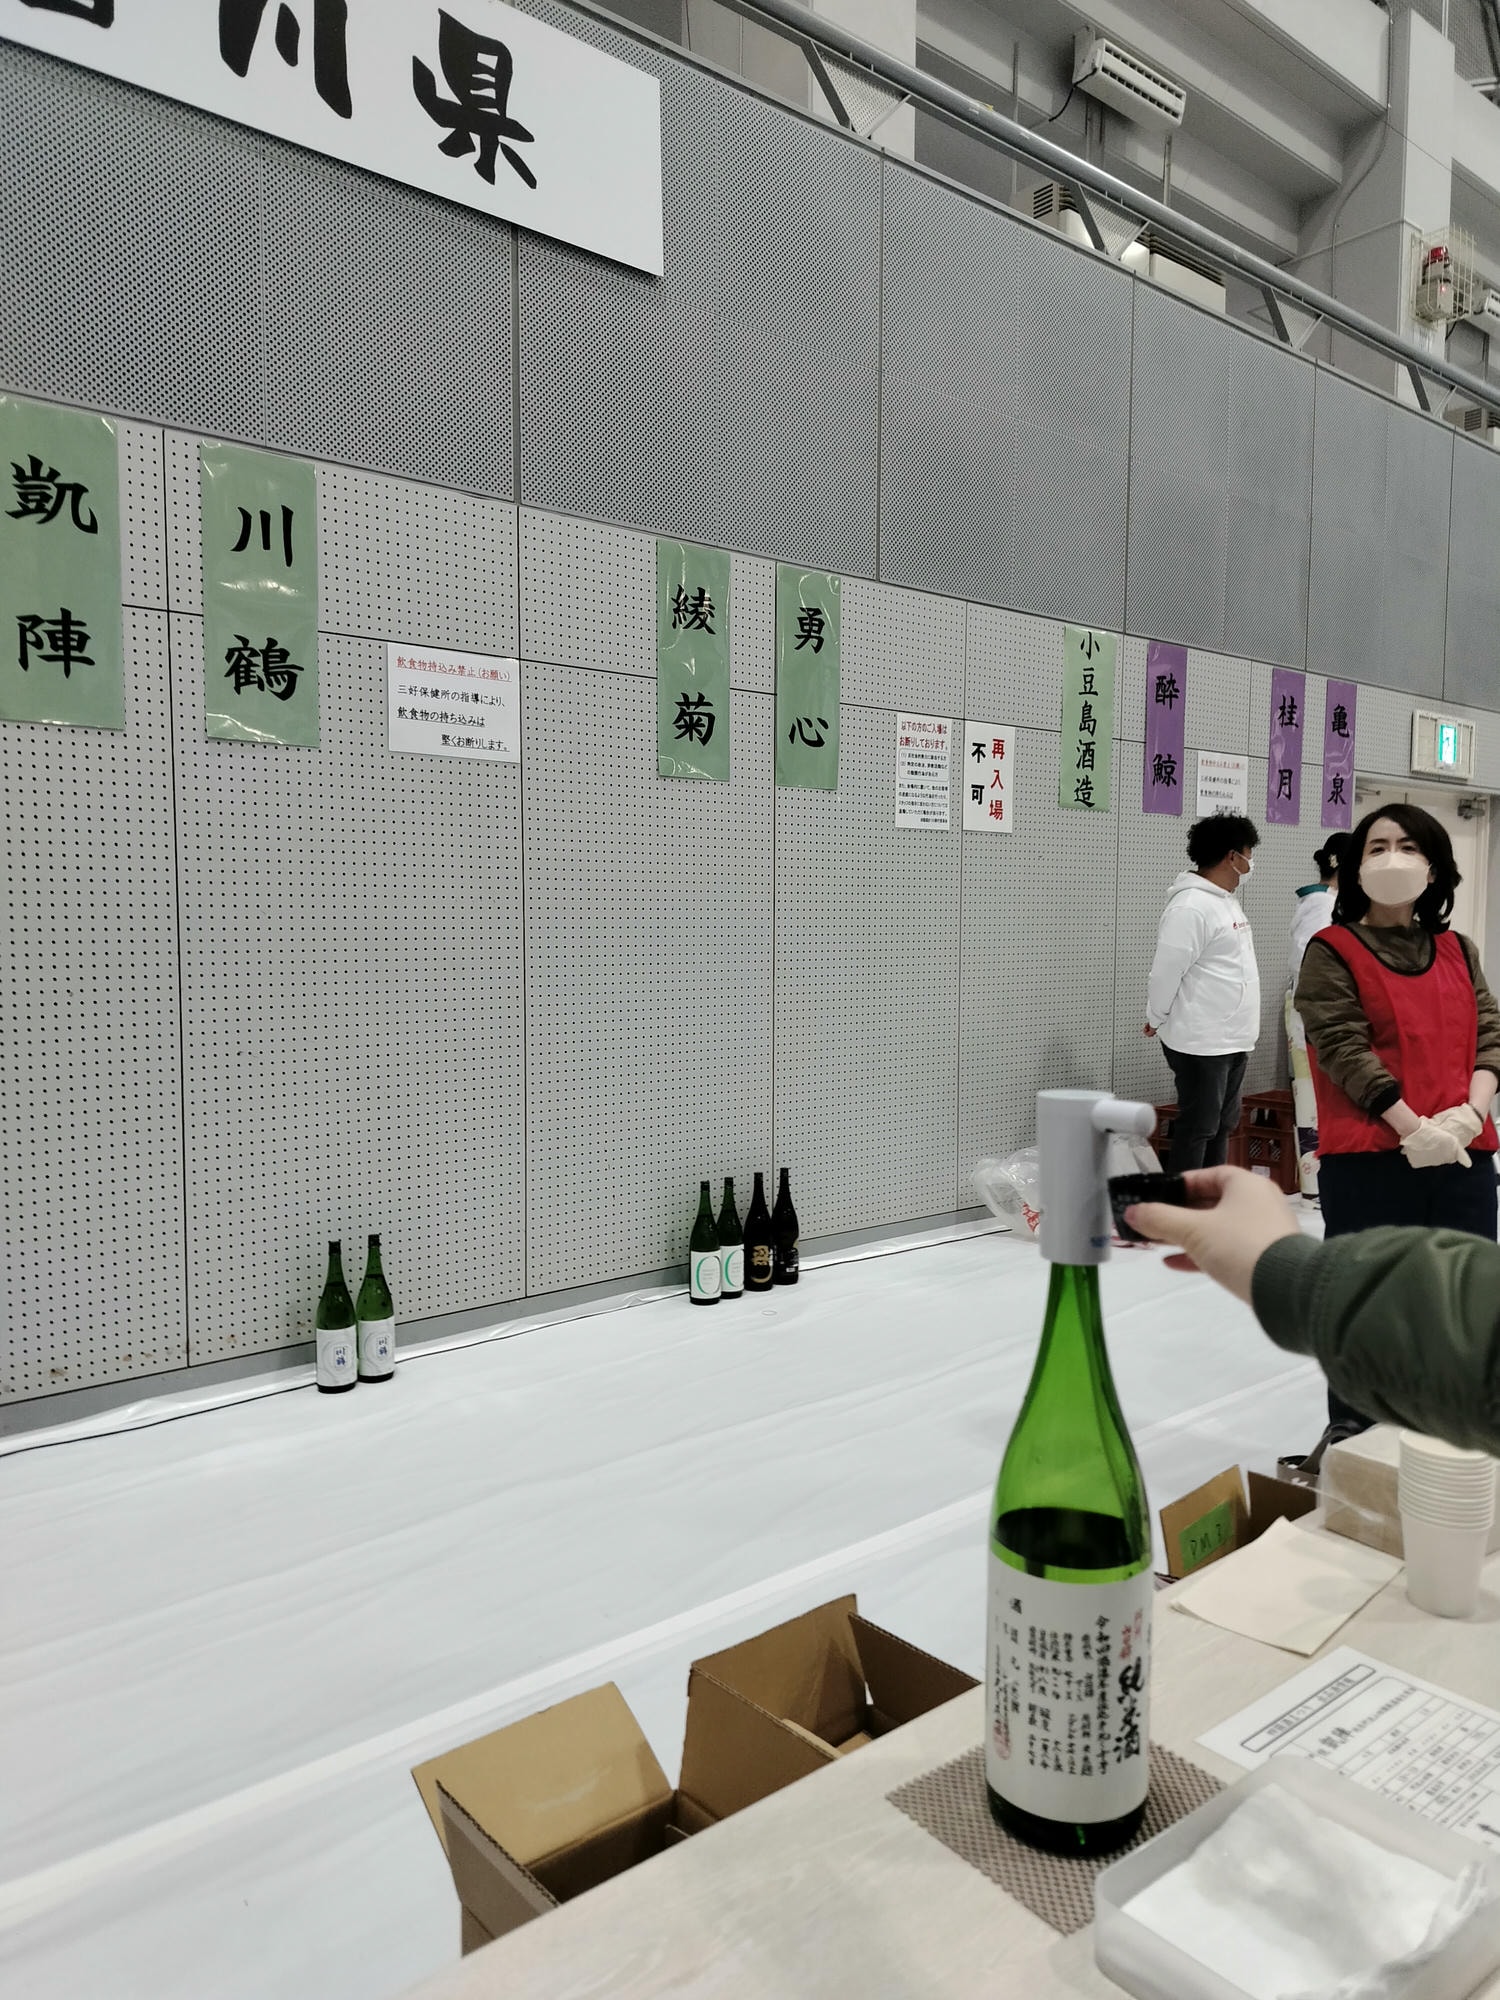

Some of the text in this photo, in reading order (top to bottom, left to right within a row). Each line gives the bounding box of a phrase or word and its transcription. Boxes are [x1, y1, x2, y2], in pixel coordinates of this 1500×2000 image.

[18, 0, 537, 190] 川県
[5, 454, 99, 679] 凱陣
[224, 505, 305, 701] 川鶴
[397, 685, 505, 707] 三好保健所の指導により、
[397, 706, 486, 727] 飲食物の持ち込みは
[671, 584, 716, 746] 綾菊
[788, 607, 829, 748] 勇心
[441, 734, 510, 751] 堅くお断りします。
[901, 721, 948, 735] 以下の方のご入場は
[1073, 631, 1100, 808] 小豆島酒造
[1153, 673, 1180, 787] 酔鯨
[1276, 695, 1299, 801] 桂月
[1328, 704, 1350, 805] 亀泉
[970, 742, 987, 806] 不可
[989, 738, 1005, 821] 再入場
